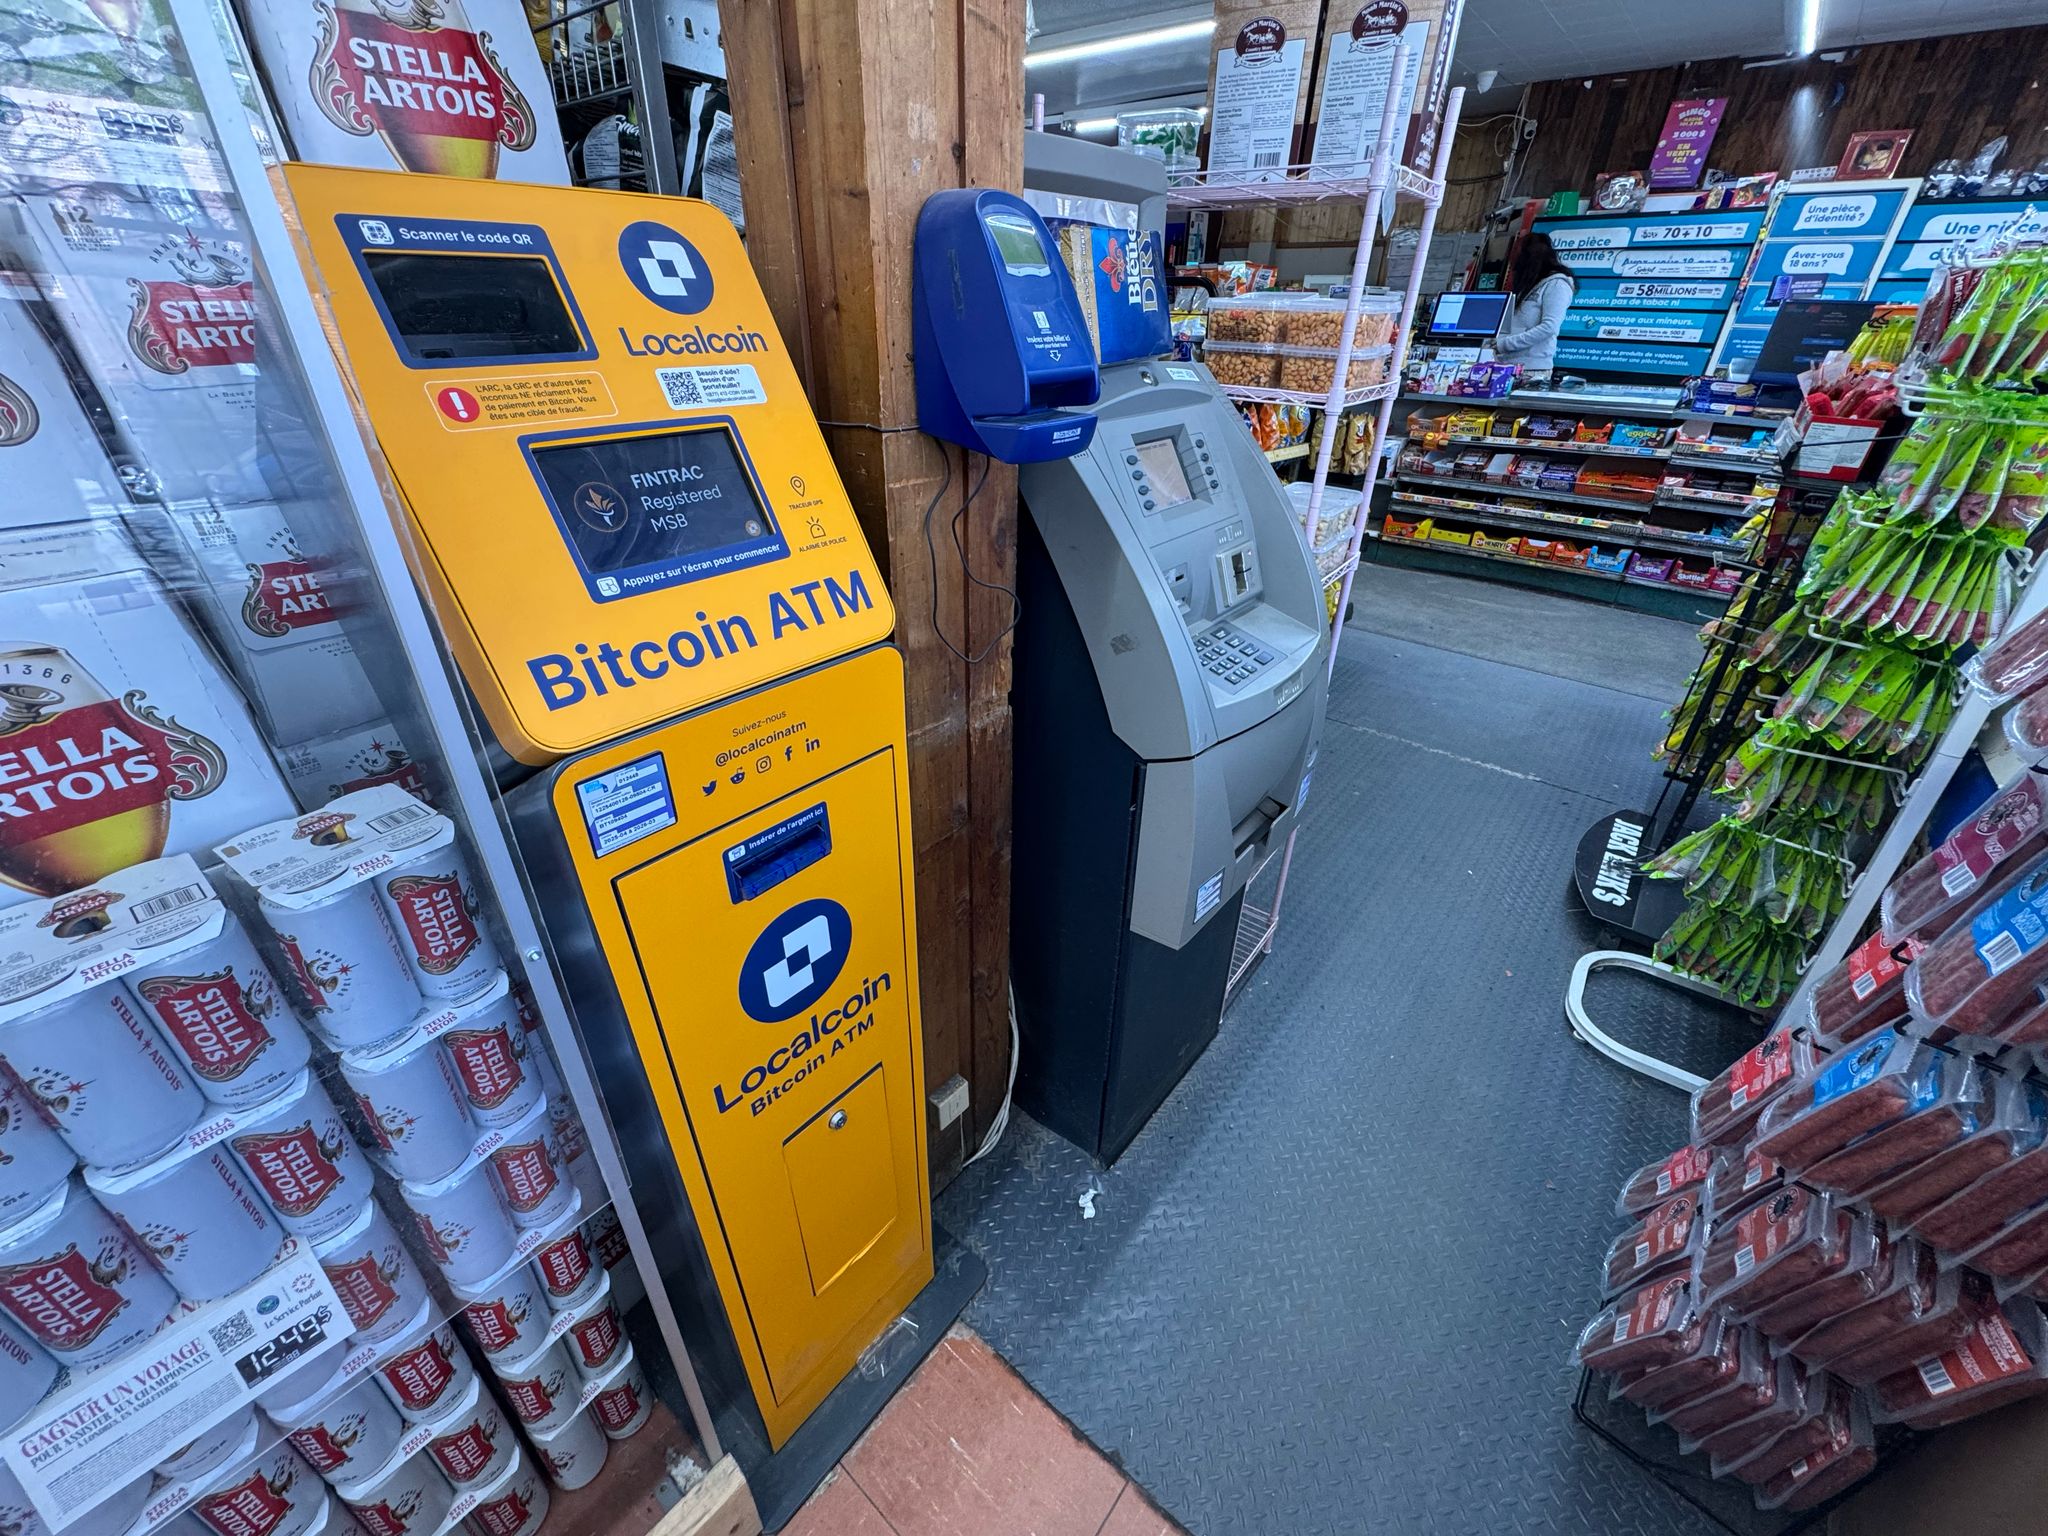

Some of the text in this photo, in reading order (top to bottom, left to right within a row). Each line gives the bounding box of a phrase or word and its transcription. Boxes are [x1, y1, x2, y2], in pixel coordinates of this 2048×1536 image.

[1379, 1, 1402, 12] Martin's
[349, 37, 488, 85] STELLA
[364, 75, 496, 119] ARTOIS
[1679, 108, 1711, 119] BINGO
[1666, 149, 1698, 157] VENTE
[1672, 156, 1687, 164] ICI
[1804, 213, 1857, 223] d'identité
[1807, 204, 1862, 216] Une pièce
[399, 228, 533, 245] Scanner le code QR
[1552, 236, 1612, 250] Une pièce
[1663, 226, 1712, 239] 70 10
[1944, 222, 1981, 235] Une
[150, 240, 177, 264] ANNO
[1792, 251, 1845, 259] Avez-vous
[1138, 230, 1158, 312] DRY
[1636, 284, 1655, 297] 58
[1643, 298, 1669, 306] tabac
[1671, 298, 1680, 306] ni
[1595, 316, 1635, 325] vapotage
[1656, 316, 1694, 325] mineurs.
[618, 325, 769, 356] Localcoin
[1620, 350, 1644, 358] produits
[1654, 353, 1684, 361] vapotage
[1641, 358, 1657, 367] pièce
[475, 384, 503, 393] L'ARC,
[503, 383, 511, 391] la
[513, 381, 531, 390] GRC
[544, 379, 573, 388] d'autres
[575, 378, 592, 386] tiers
[480, 391, 518, 401] inconnus
[532, 388, 570, 398] réclament
[572, 386, 588, 395] PAS
[485, 403, 496, 411] de
[498, 400, 536, 412] paiement
[549, 396, 577, 406] Bitcoin.
[578, 395, 597, 403] Vous
[489, 404, 586, 421] êtes une cible de fraude.
[630, 465, 704, 489] FINTRAC
[640, 484, 722, 511] Registered
[789, 499, 824, 511] TRACEUR GPS
[651, 513, 688, 533] MSB
[266, 527, 290, 549] ANNO
[798, 543, 820, 553] ALARME
[829, 536, 847, 546] POLICE
[1484, 540, 1507, 549] HENRY!
[622, 543, 780, 589] Appuyez sur l'écran pour commencer
[1594, 558, 1618, 566] Skittles
[1634, 565, 1661, 574] Skittles
[1677, 573, 1706, 582] Skittles
[526, 570, 873, 711] Bitcoin ATM
[3, 664, 72, 684] 1366
[732, 710, 786, 738] Suivez-nous
[715, 720, 807, 767] @localcoinatm
[749, 806, 824, 850] Insérer de l'argent ici
[1607, 818, 1644, 857] JACK
[411, 897, 450, 958] ARTOIS
[432, 888, 466, 950] STELLA
[168, 999, 228, 1062] ARTOIS
[197, 987, 252, 1056] STELLA
[713, 972, 891, 1114] Localcoin
[33, 1067, 70, 1081] ANNO
[463, 1047, 495, 1095] ARTOIS
[482, 1038, 512, 1089] STELLA
[749, 1013, 875, 1117] Bitcoin ATM
[256, 1151, 303, 1202] ARTOIS
[281, 1140, 325, 1195] STELLA
[506, 1160, 534, 1200] ARTOIS
[523, 1150, 548, 1195] STELLA
[548, 1251, 572, 1287] ARTOIS
[563, 1241, 584, 1279] STELLA
[5, 1283, 76, 1336] ARTOIS
[36, 1267, 102, 1326] STELLA
[264, 1289, 323, 1330] Le Service Parfait
[480, 1309, 506, 1347] STELLA
[396, 1364, 430, 1400] ARTOIS
[414, 1351, 444, 1390] STELLA
[21, 1399, 106, 1459] GAGNER
[103, 1381, 133, 1406] UN
[133, 1337, 205, 1386] VOYAGE
[30, 1442, 63, 1469] POUR
[64, 1413, 112, 1447] ASSISTER
[113, 1400, 135, 1417] AUX
[134, 1351, 211, 1402] CHAMPIONNATS
[85, 1380, 181, 1446] LONDRES, EN ANGLETERRE
[458, 1435, 486, 1467] STELLA
[232, 1491, 275, 1528] STELLA
